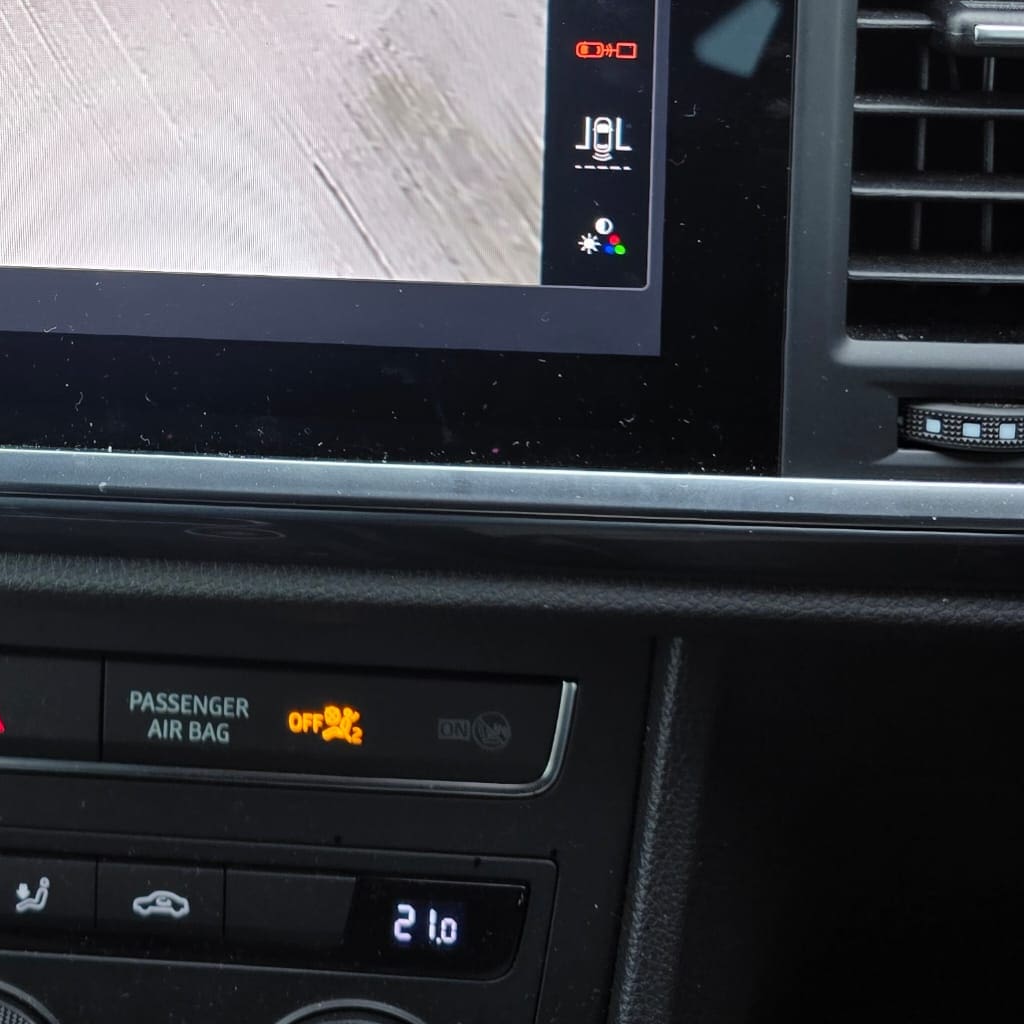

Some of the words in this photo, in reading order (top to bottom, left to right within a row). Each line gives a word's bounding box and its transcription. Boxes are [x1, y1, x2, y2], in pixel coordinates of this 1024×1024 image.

[129, 690, 249, 719] PASSENGER
[147, 718, 183, 740] AIR
[189, 721, 230, 743] BAG
[288, 711, 324, 734] OFF
[393, 903, 458, 945] 21.0
